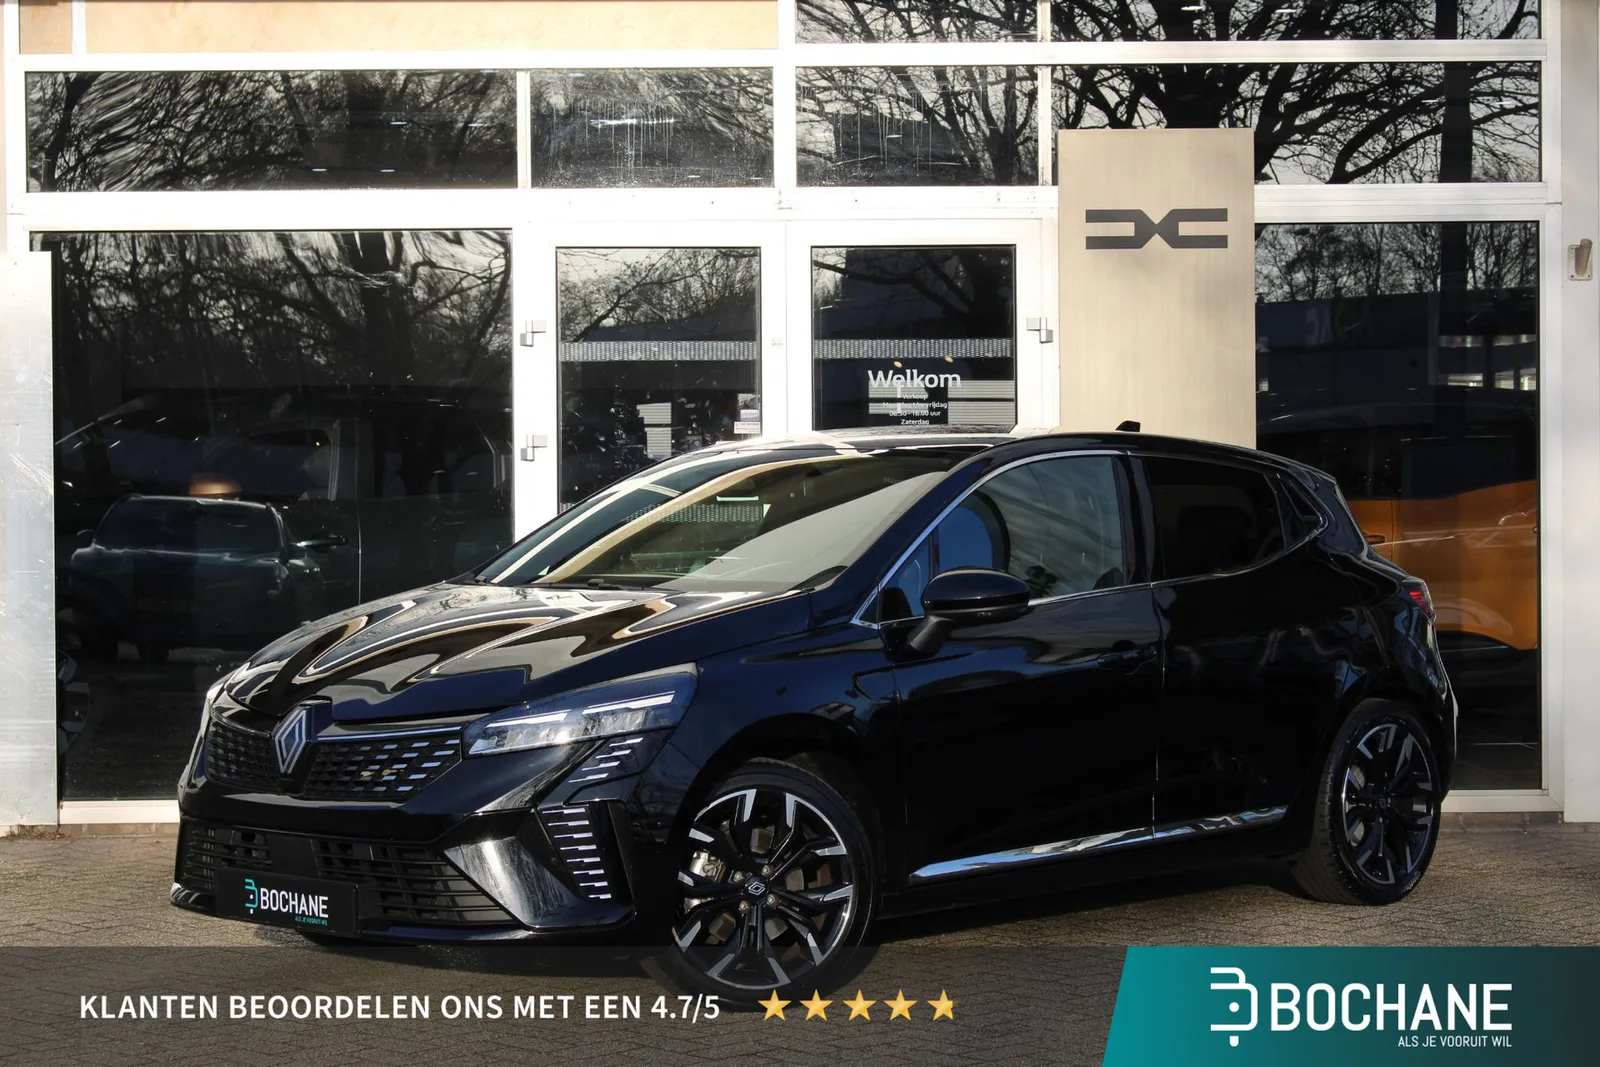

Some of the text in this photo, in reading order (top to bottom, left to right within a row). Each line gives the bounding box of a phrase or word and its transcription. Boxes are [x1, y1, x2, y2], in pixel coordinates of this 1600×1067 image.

[867, 369, 961, 388] Welkom
[902, 393, 928, 401] Verkoop
[260, 887, 329, 918] BOCHANE
